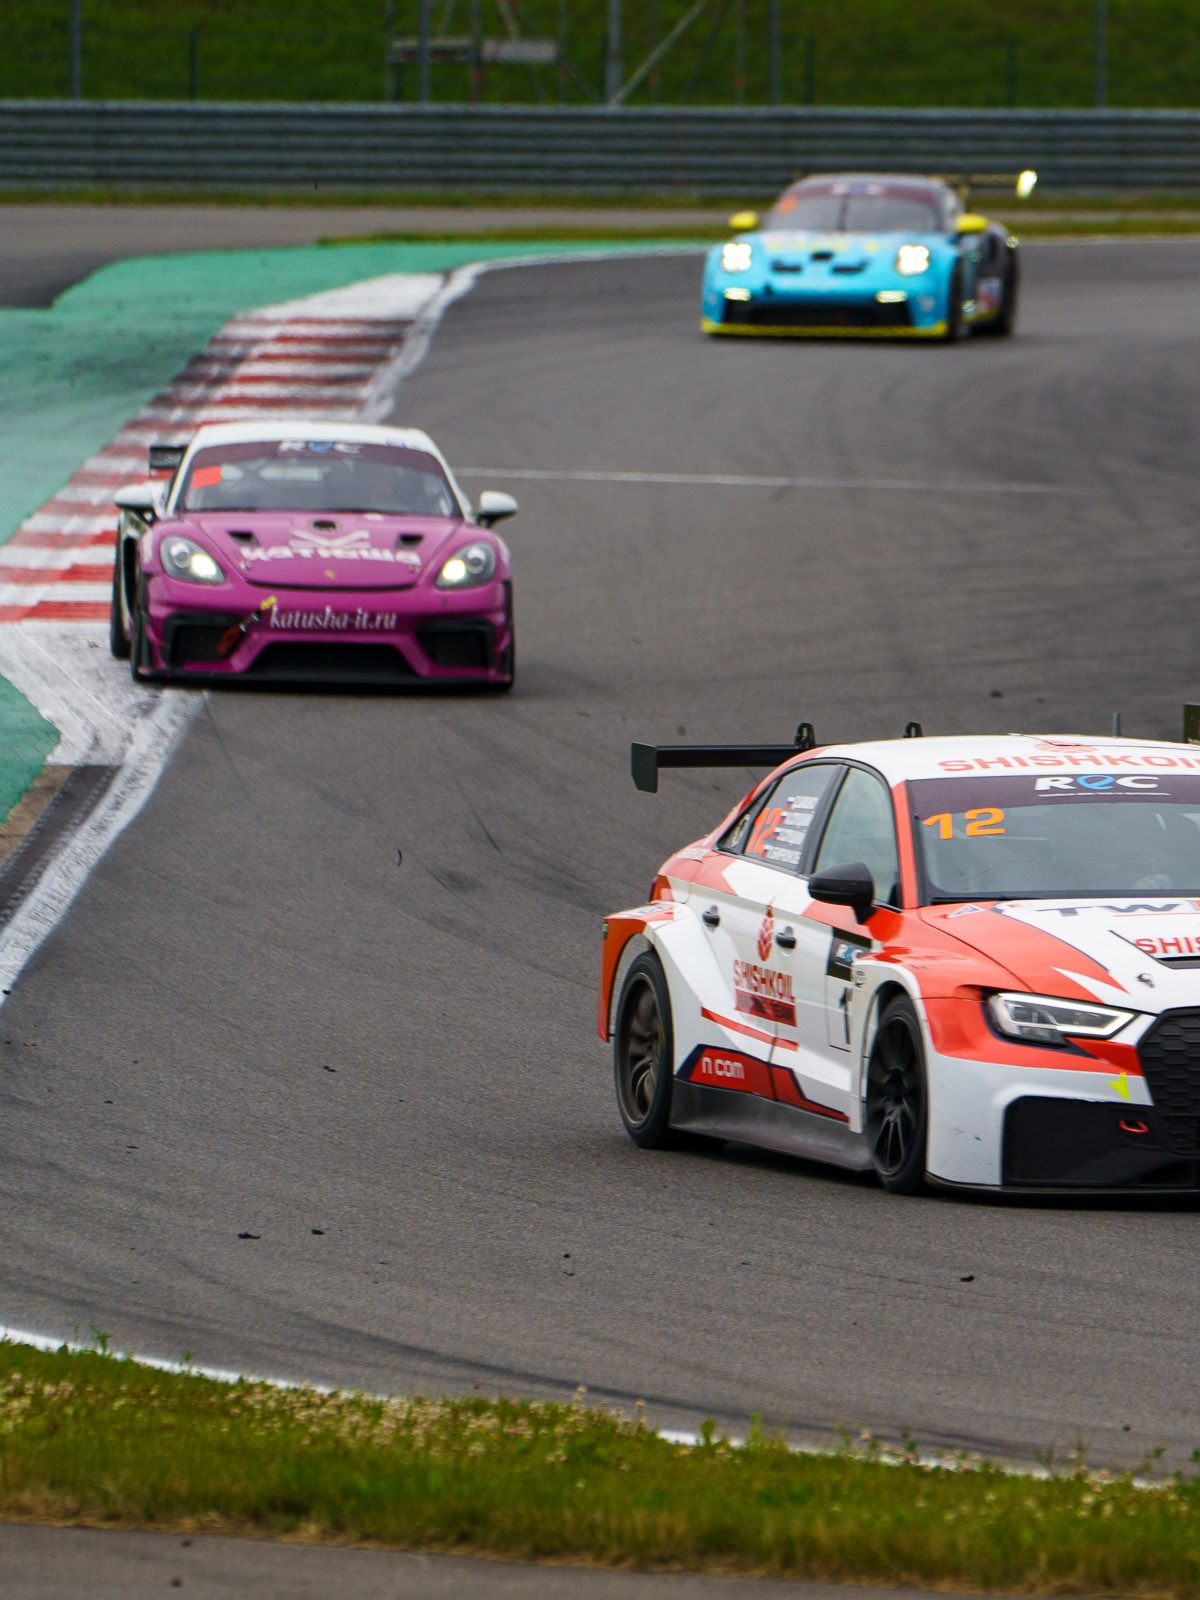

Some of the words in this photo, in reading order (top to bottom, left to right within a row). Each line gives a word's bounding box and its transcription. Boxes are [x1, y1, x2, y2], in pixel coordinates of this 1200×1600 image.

[269, 604, 398, 629] katusha-it.ru
[745, 807, 783, 853] 12
[923, 807, 1006, 840] 12
[733, 960, 796, 1003] SHISHKOIL
